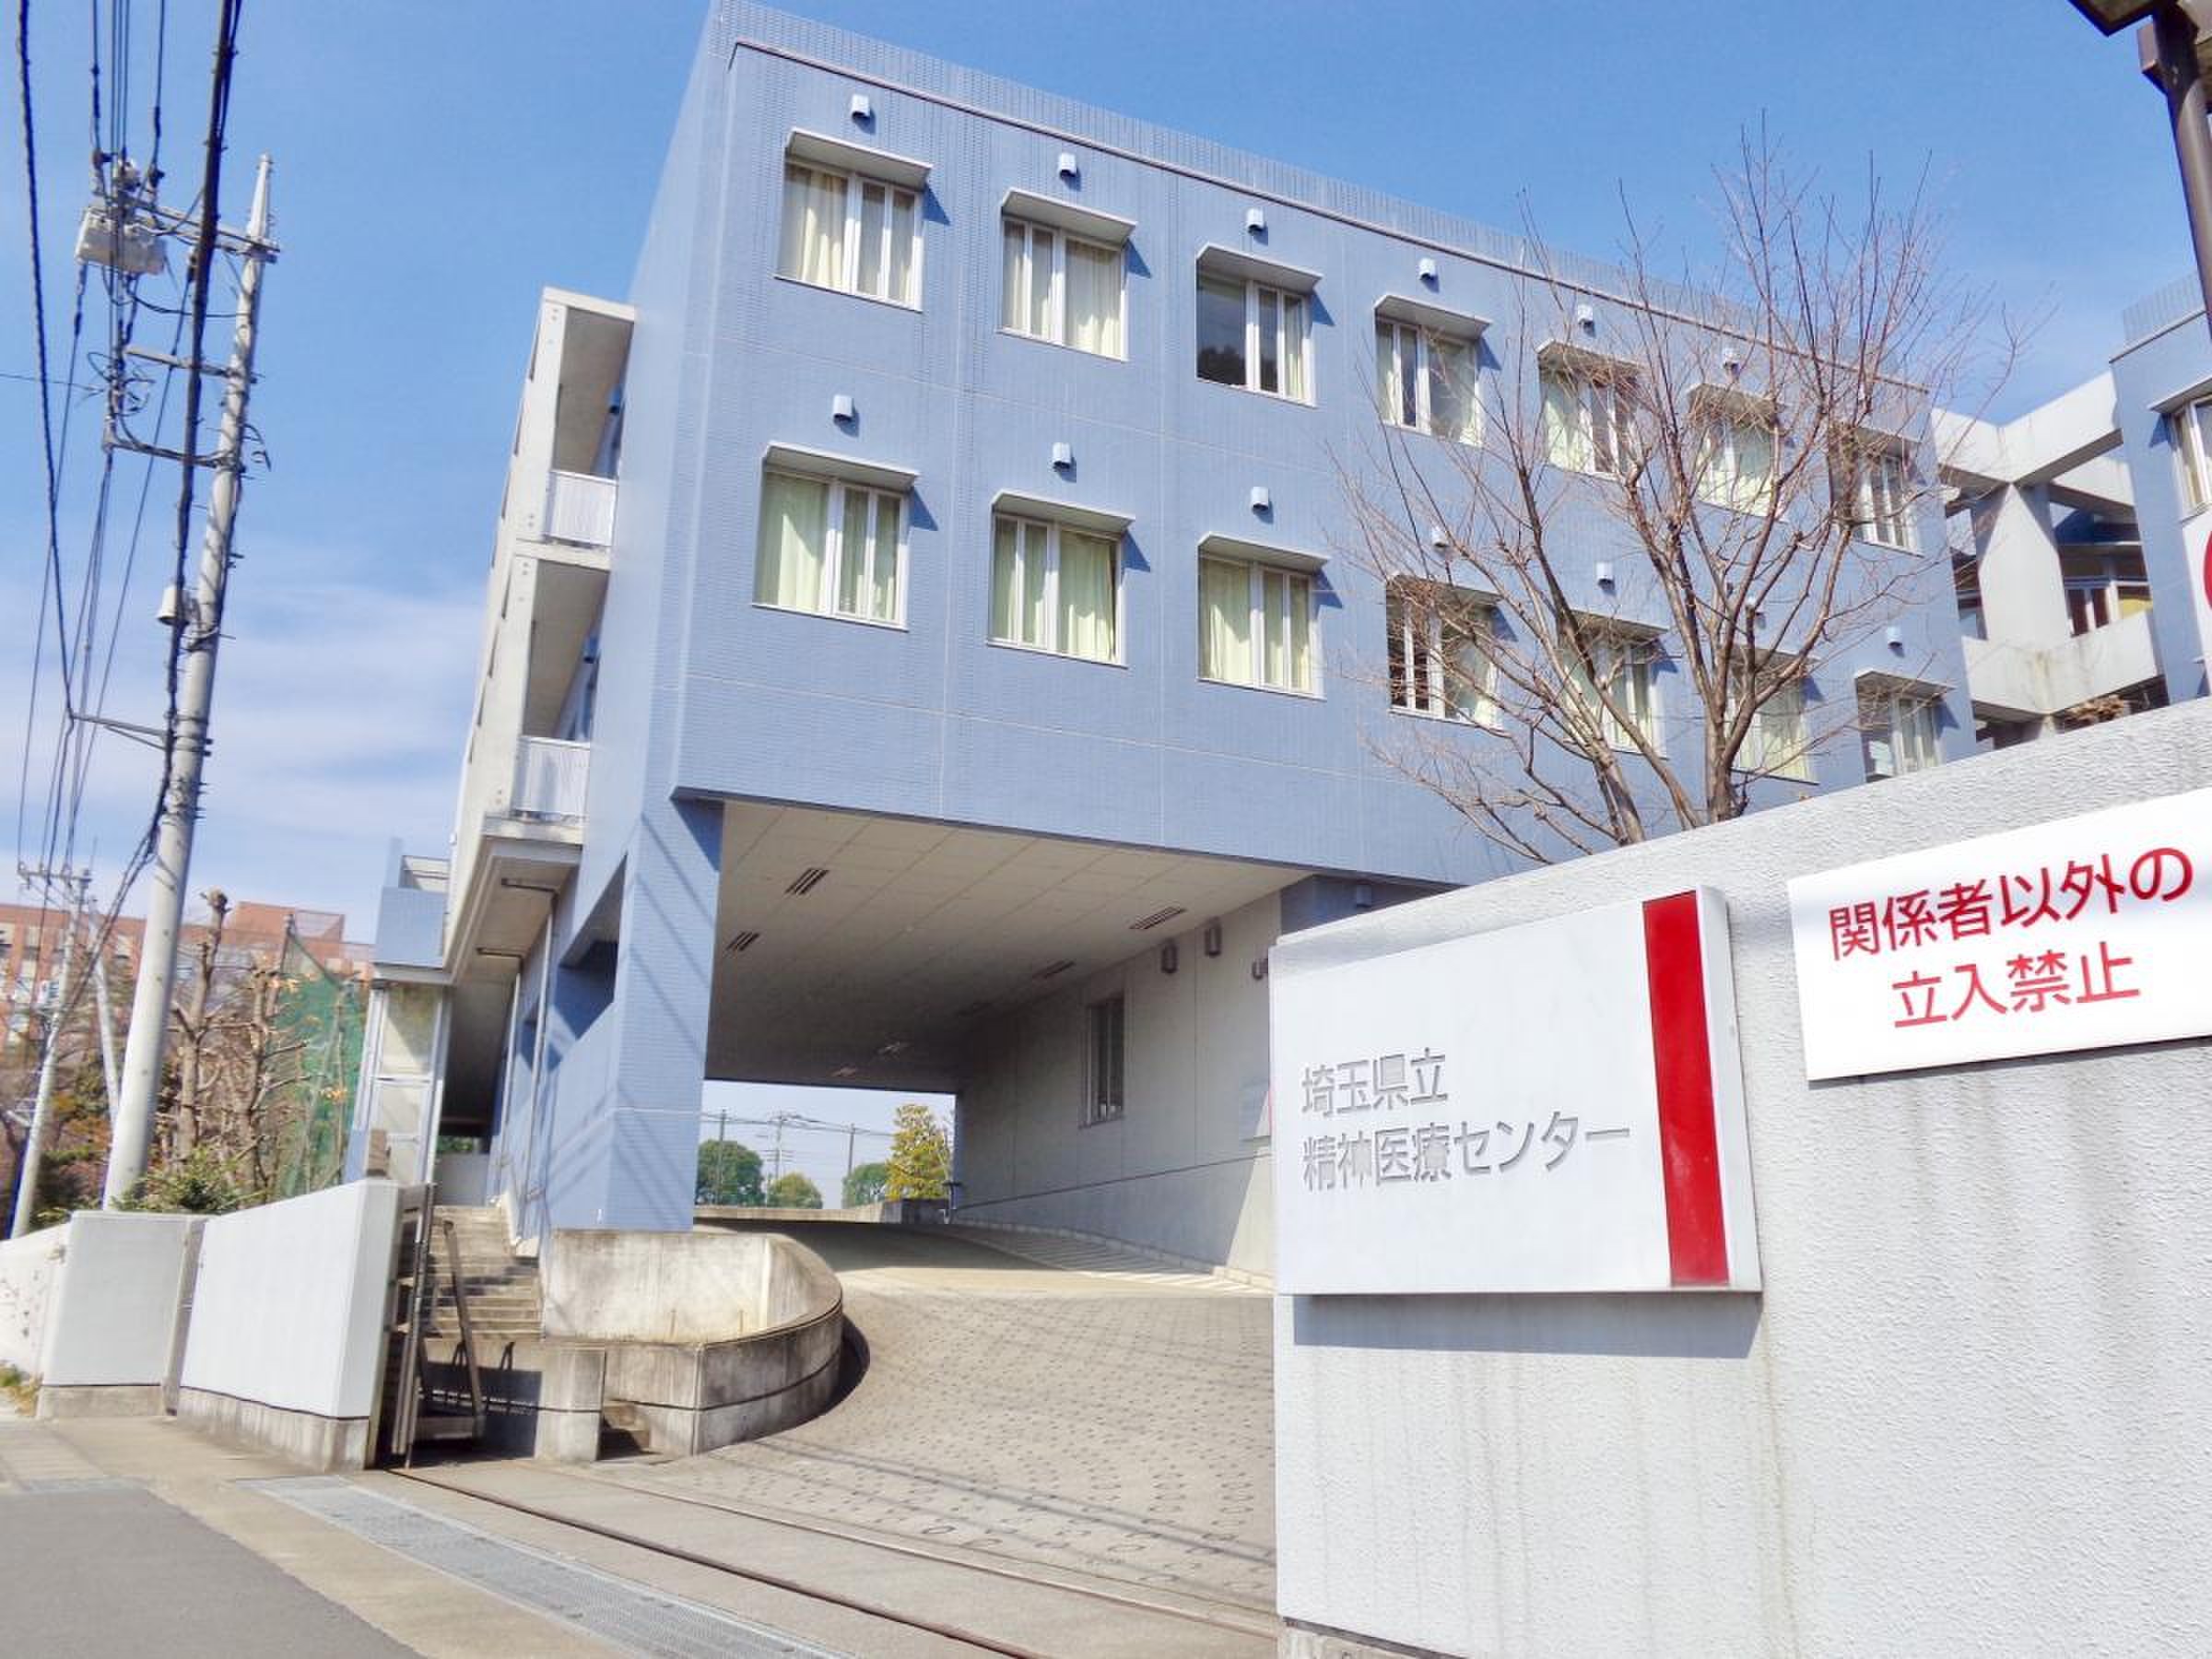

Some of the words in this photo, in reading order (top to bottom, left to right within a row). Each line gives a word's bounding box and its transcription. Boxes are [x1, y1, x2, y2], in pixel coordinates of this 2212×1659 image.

[1829, 847, 2194, 960] 関係者以外の
[1892, 942, 2140, 1028] 立入禁止
[1301, 1047, 1448, 1117] 埼玉県立
[1302, 1111, 1630, 1192] 精神医療センター
